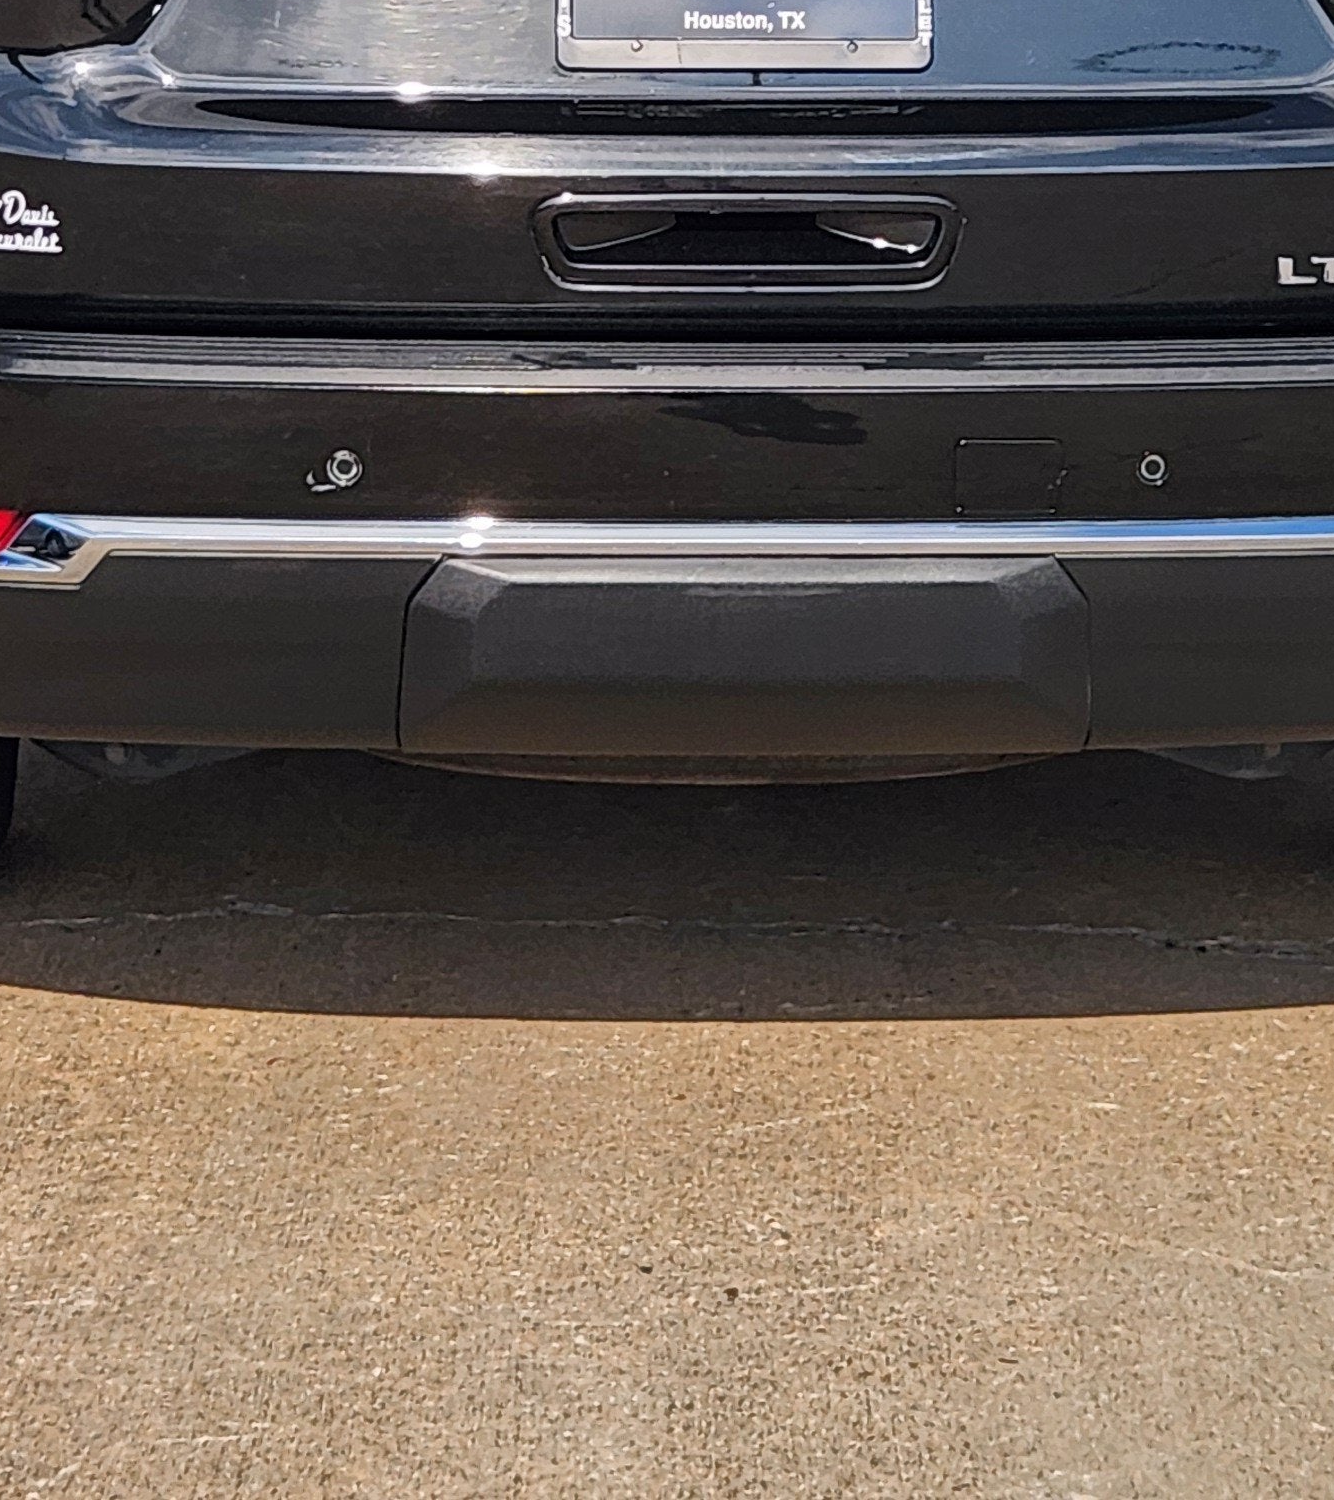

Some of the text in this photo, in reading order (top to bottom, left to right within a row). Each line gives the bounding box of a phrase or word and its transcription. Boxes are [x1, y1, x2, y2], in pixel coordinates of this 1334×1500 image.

[683, 10, 806, 33] Houston, TX
[1, 189, 60, 227] Davis
